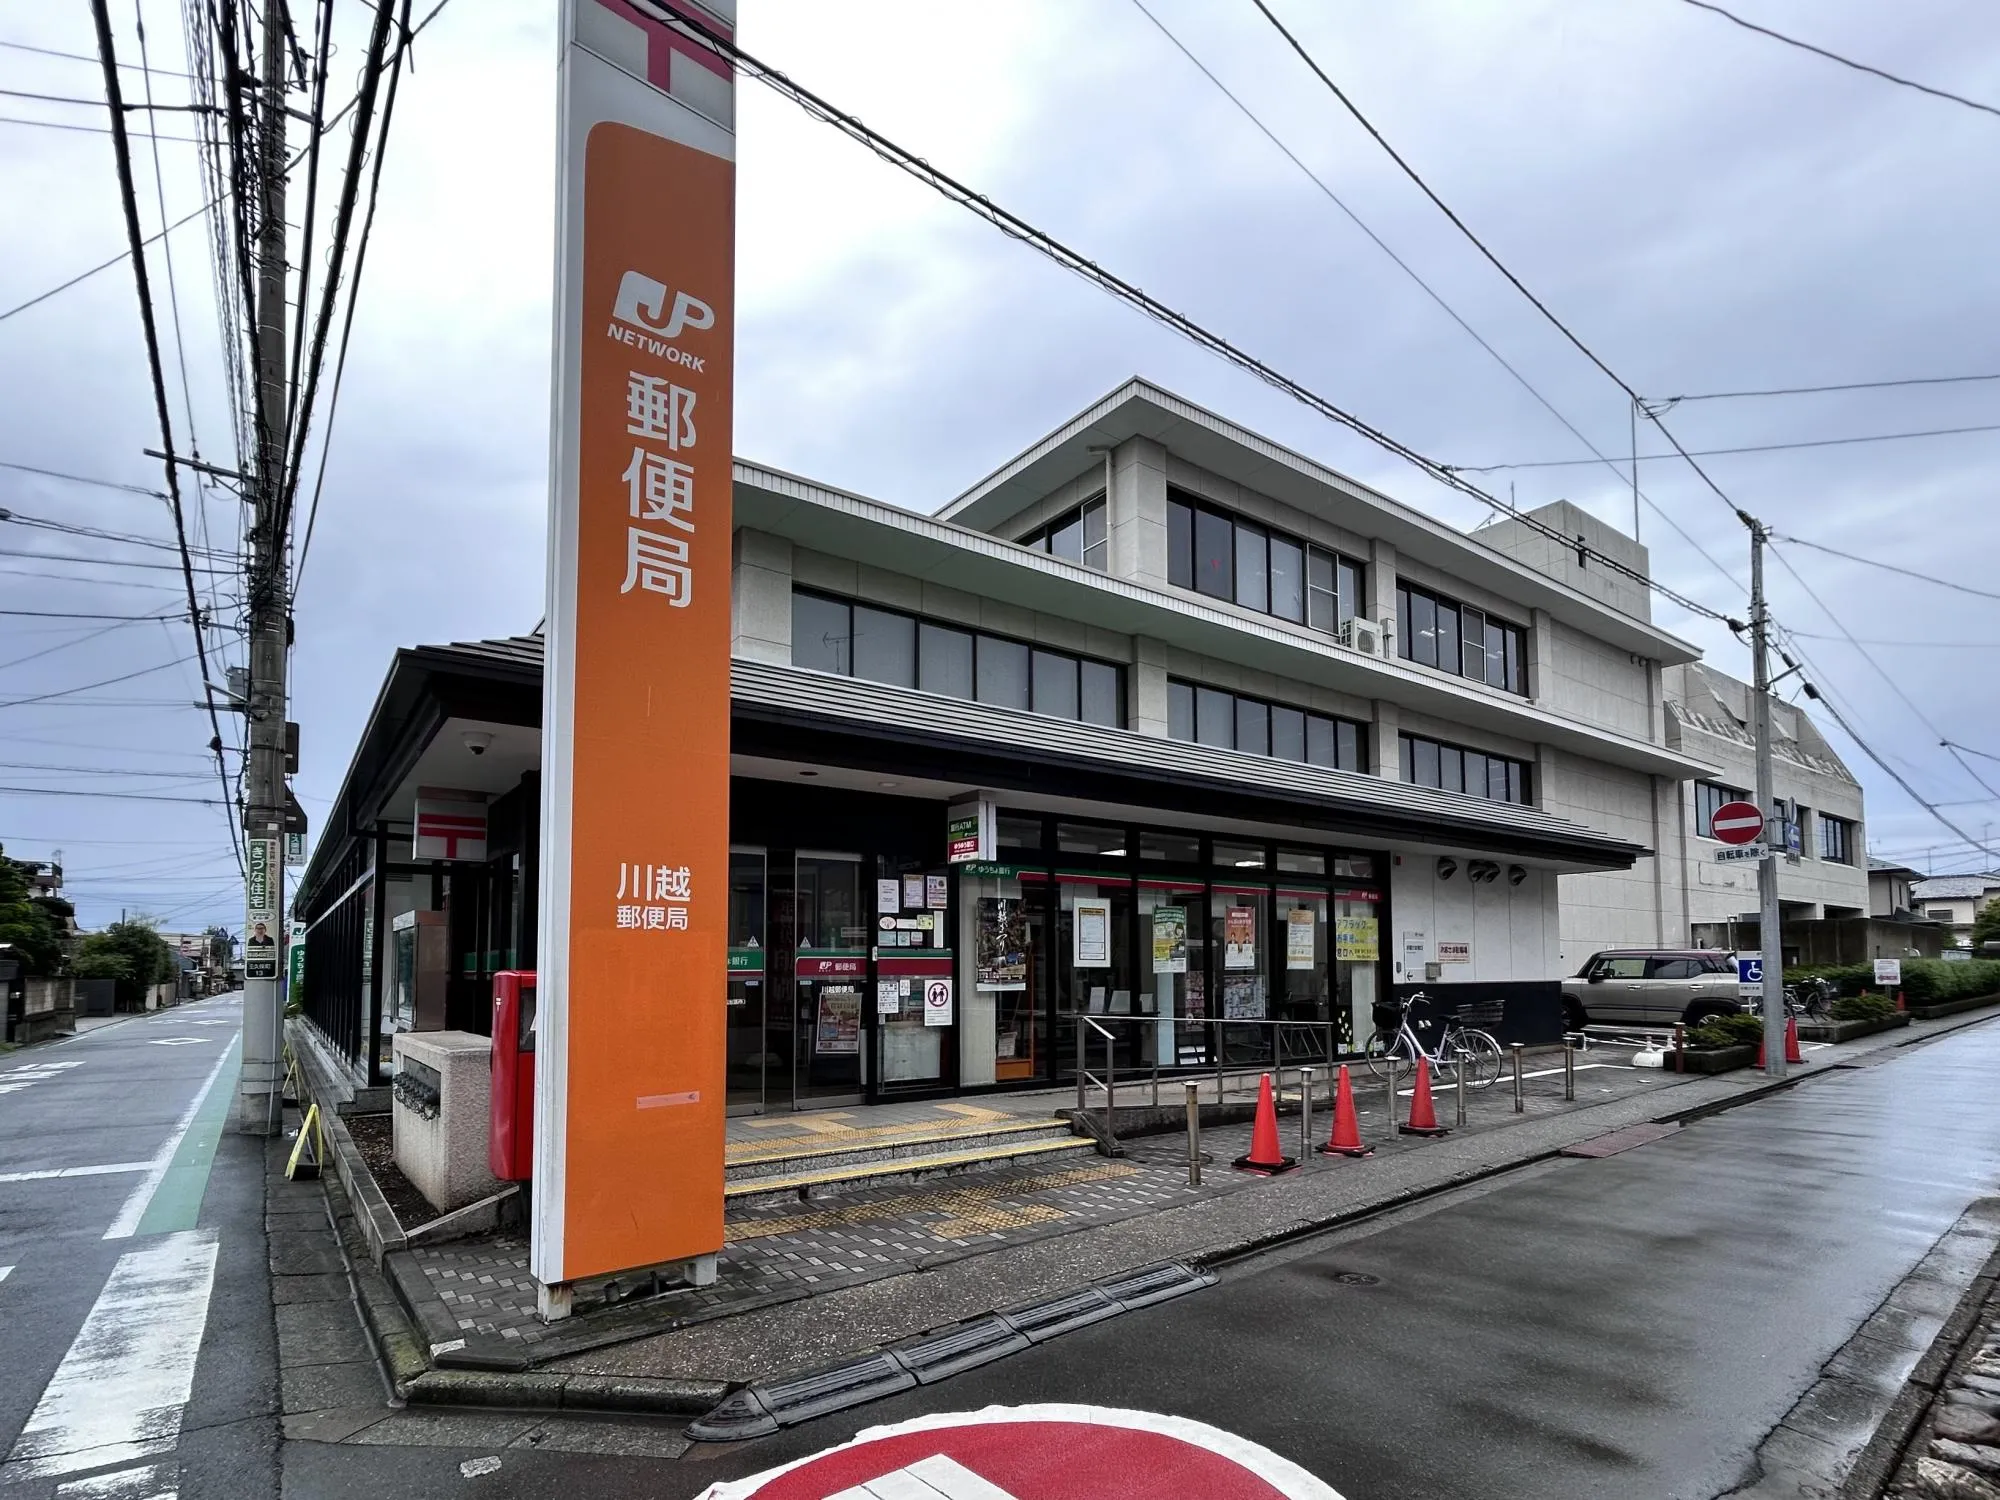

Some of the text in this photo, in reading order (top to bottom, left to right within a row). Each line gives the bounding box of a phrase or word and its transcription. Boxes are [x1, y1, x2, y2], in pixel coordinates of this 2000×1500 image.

[612, 270, 715, 338] JP
[607, 323, 706, 374] NETWORK
[620, 369, 696, 609] 郵便局
[978, 865, 1011, 875] ゆうちょ銀行
[1716, 847, 1766, 861] 自転車を除く
[250, 846, 265, 908] きづな住宅
[616, 862, 691, 902] 川越
[616, 905, 689, 930] 郵便局
[834, 962, 857, 971] 郵便局
[821, 985, 855, 994] 川越郵便局
